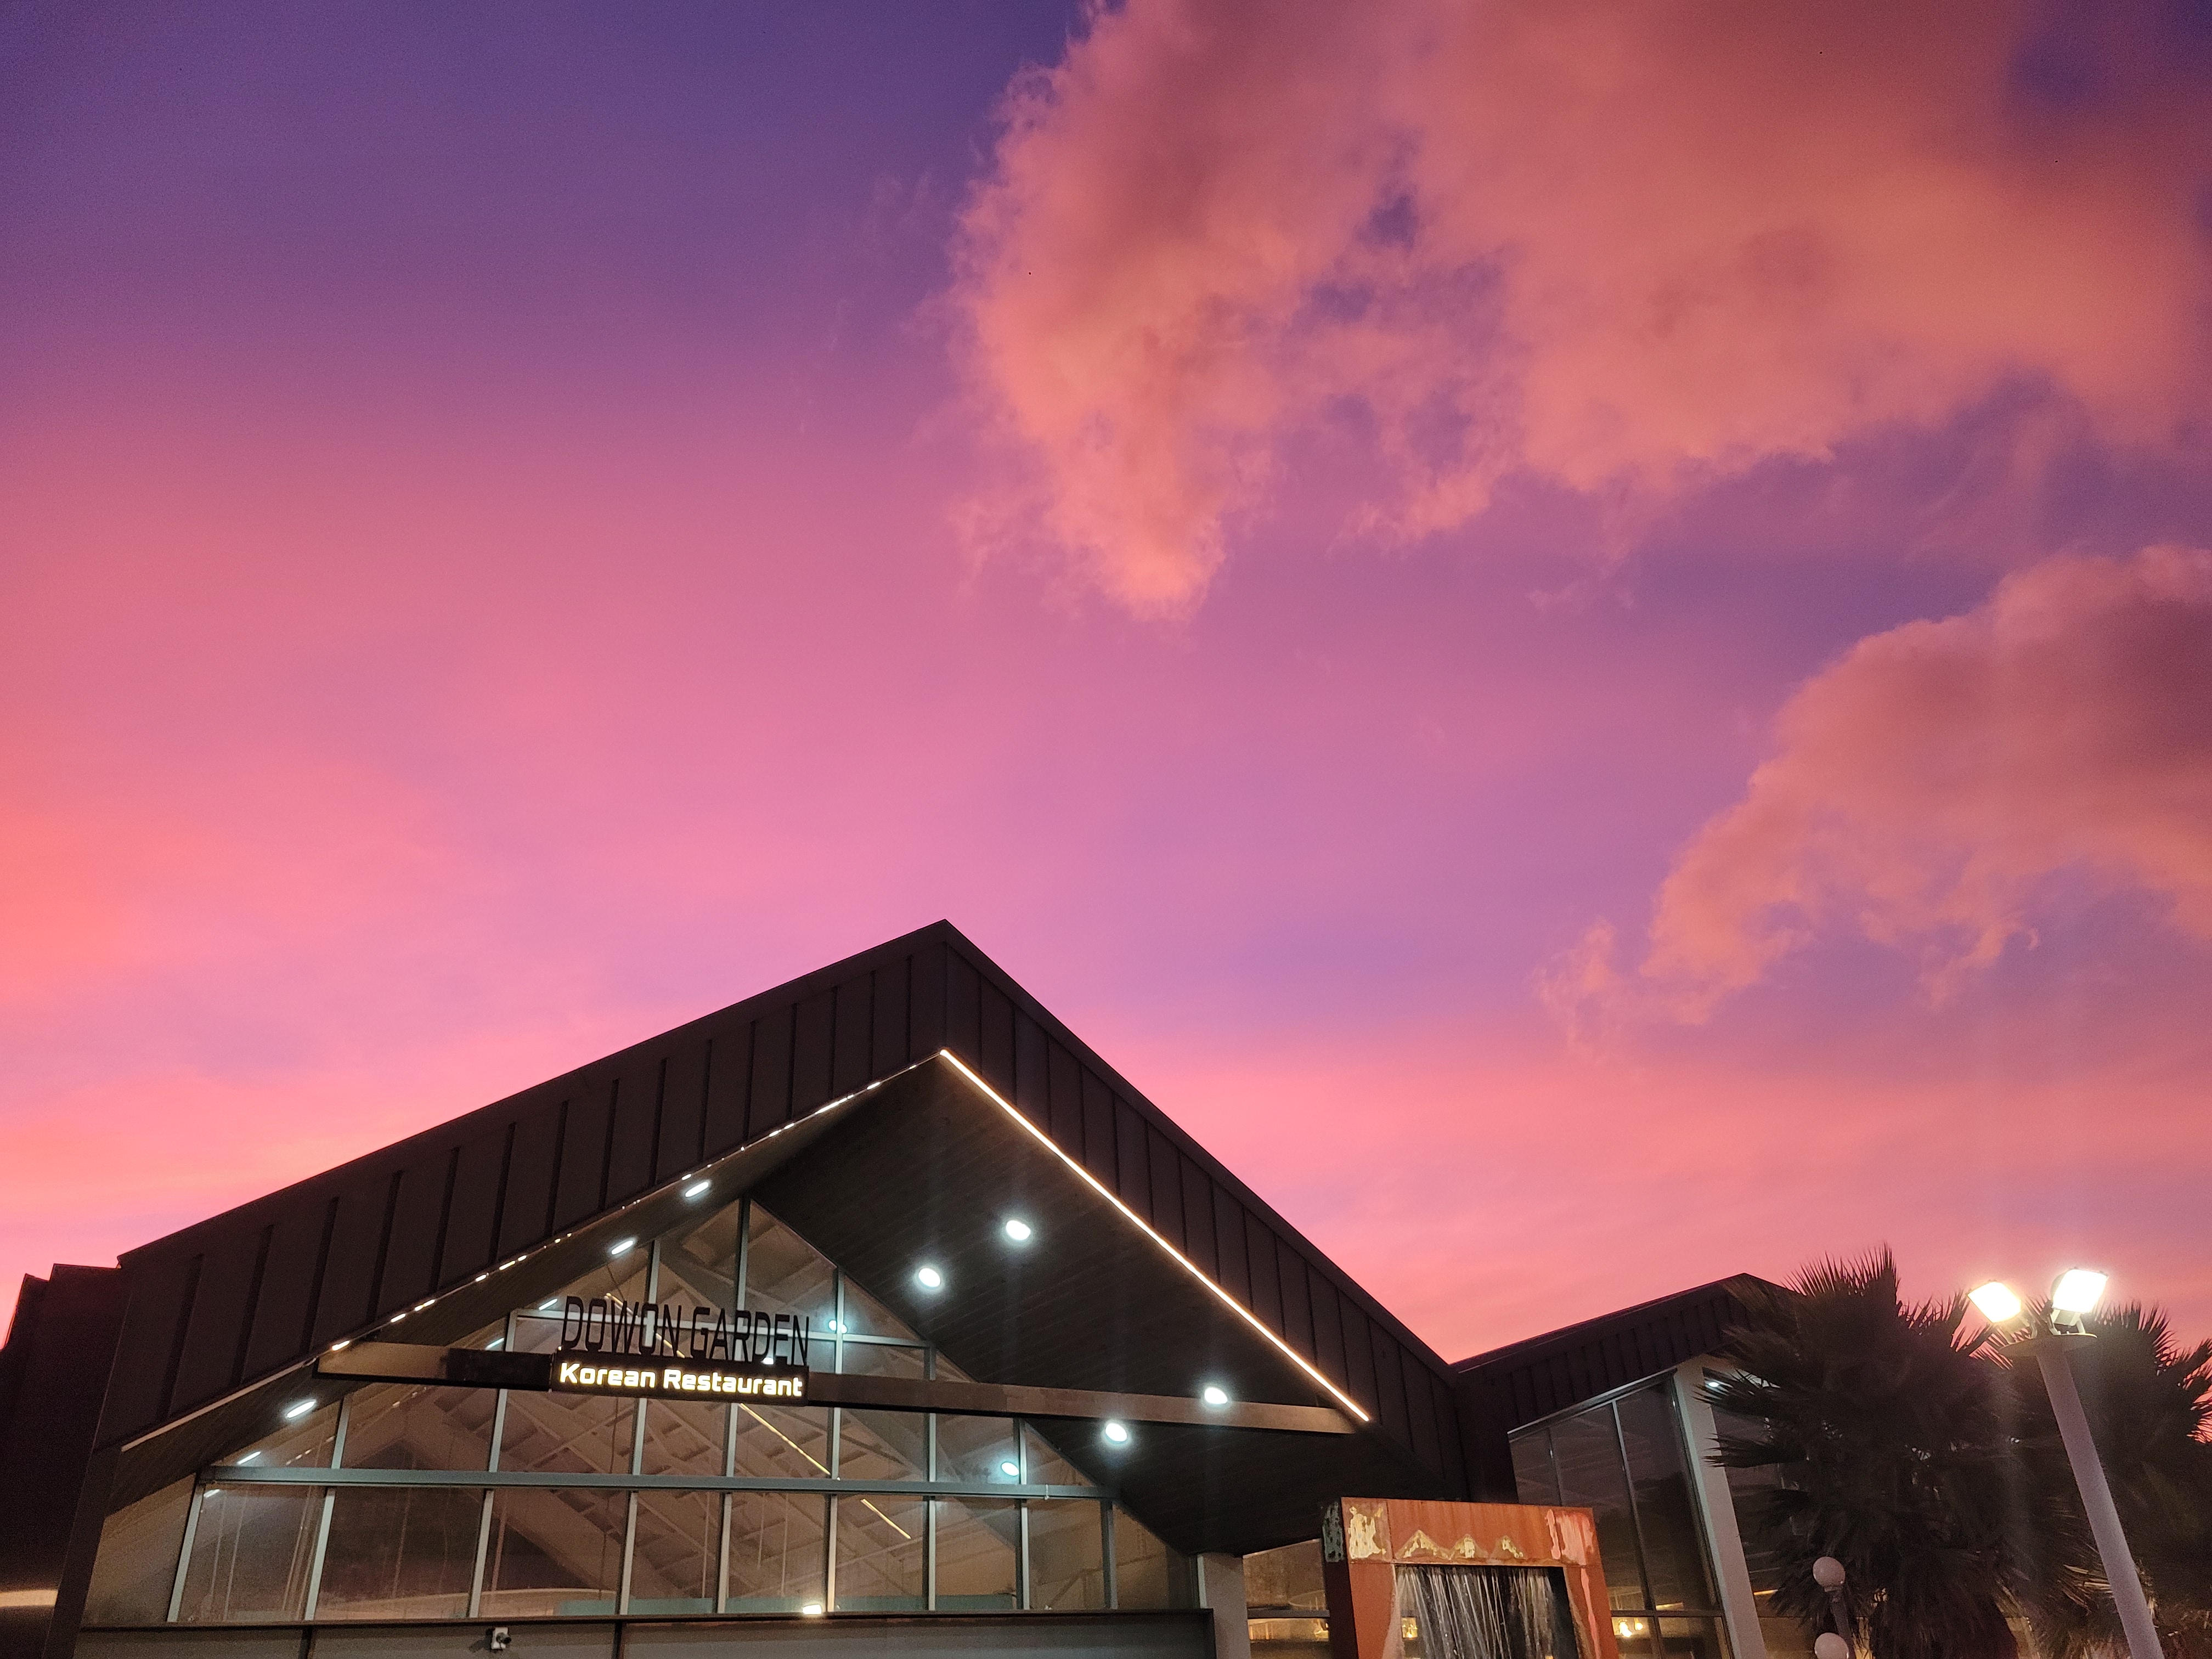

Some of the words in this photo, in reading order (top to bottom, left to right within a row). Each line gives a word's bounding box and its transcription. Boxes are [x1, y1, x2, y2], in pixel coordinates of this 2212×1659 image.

[562, 1295, 682, 1358] DOWON
[689, 1306, 809, 1366] GARDEN
[559, 1362, 656, 1389] Korean
[663, 1369, 803, 1397] Restaurant
